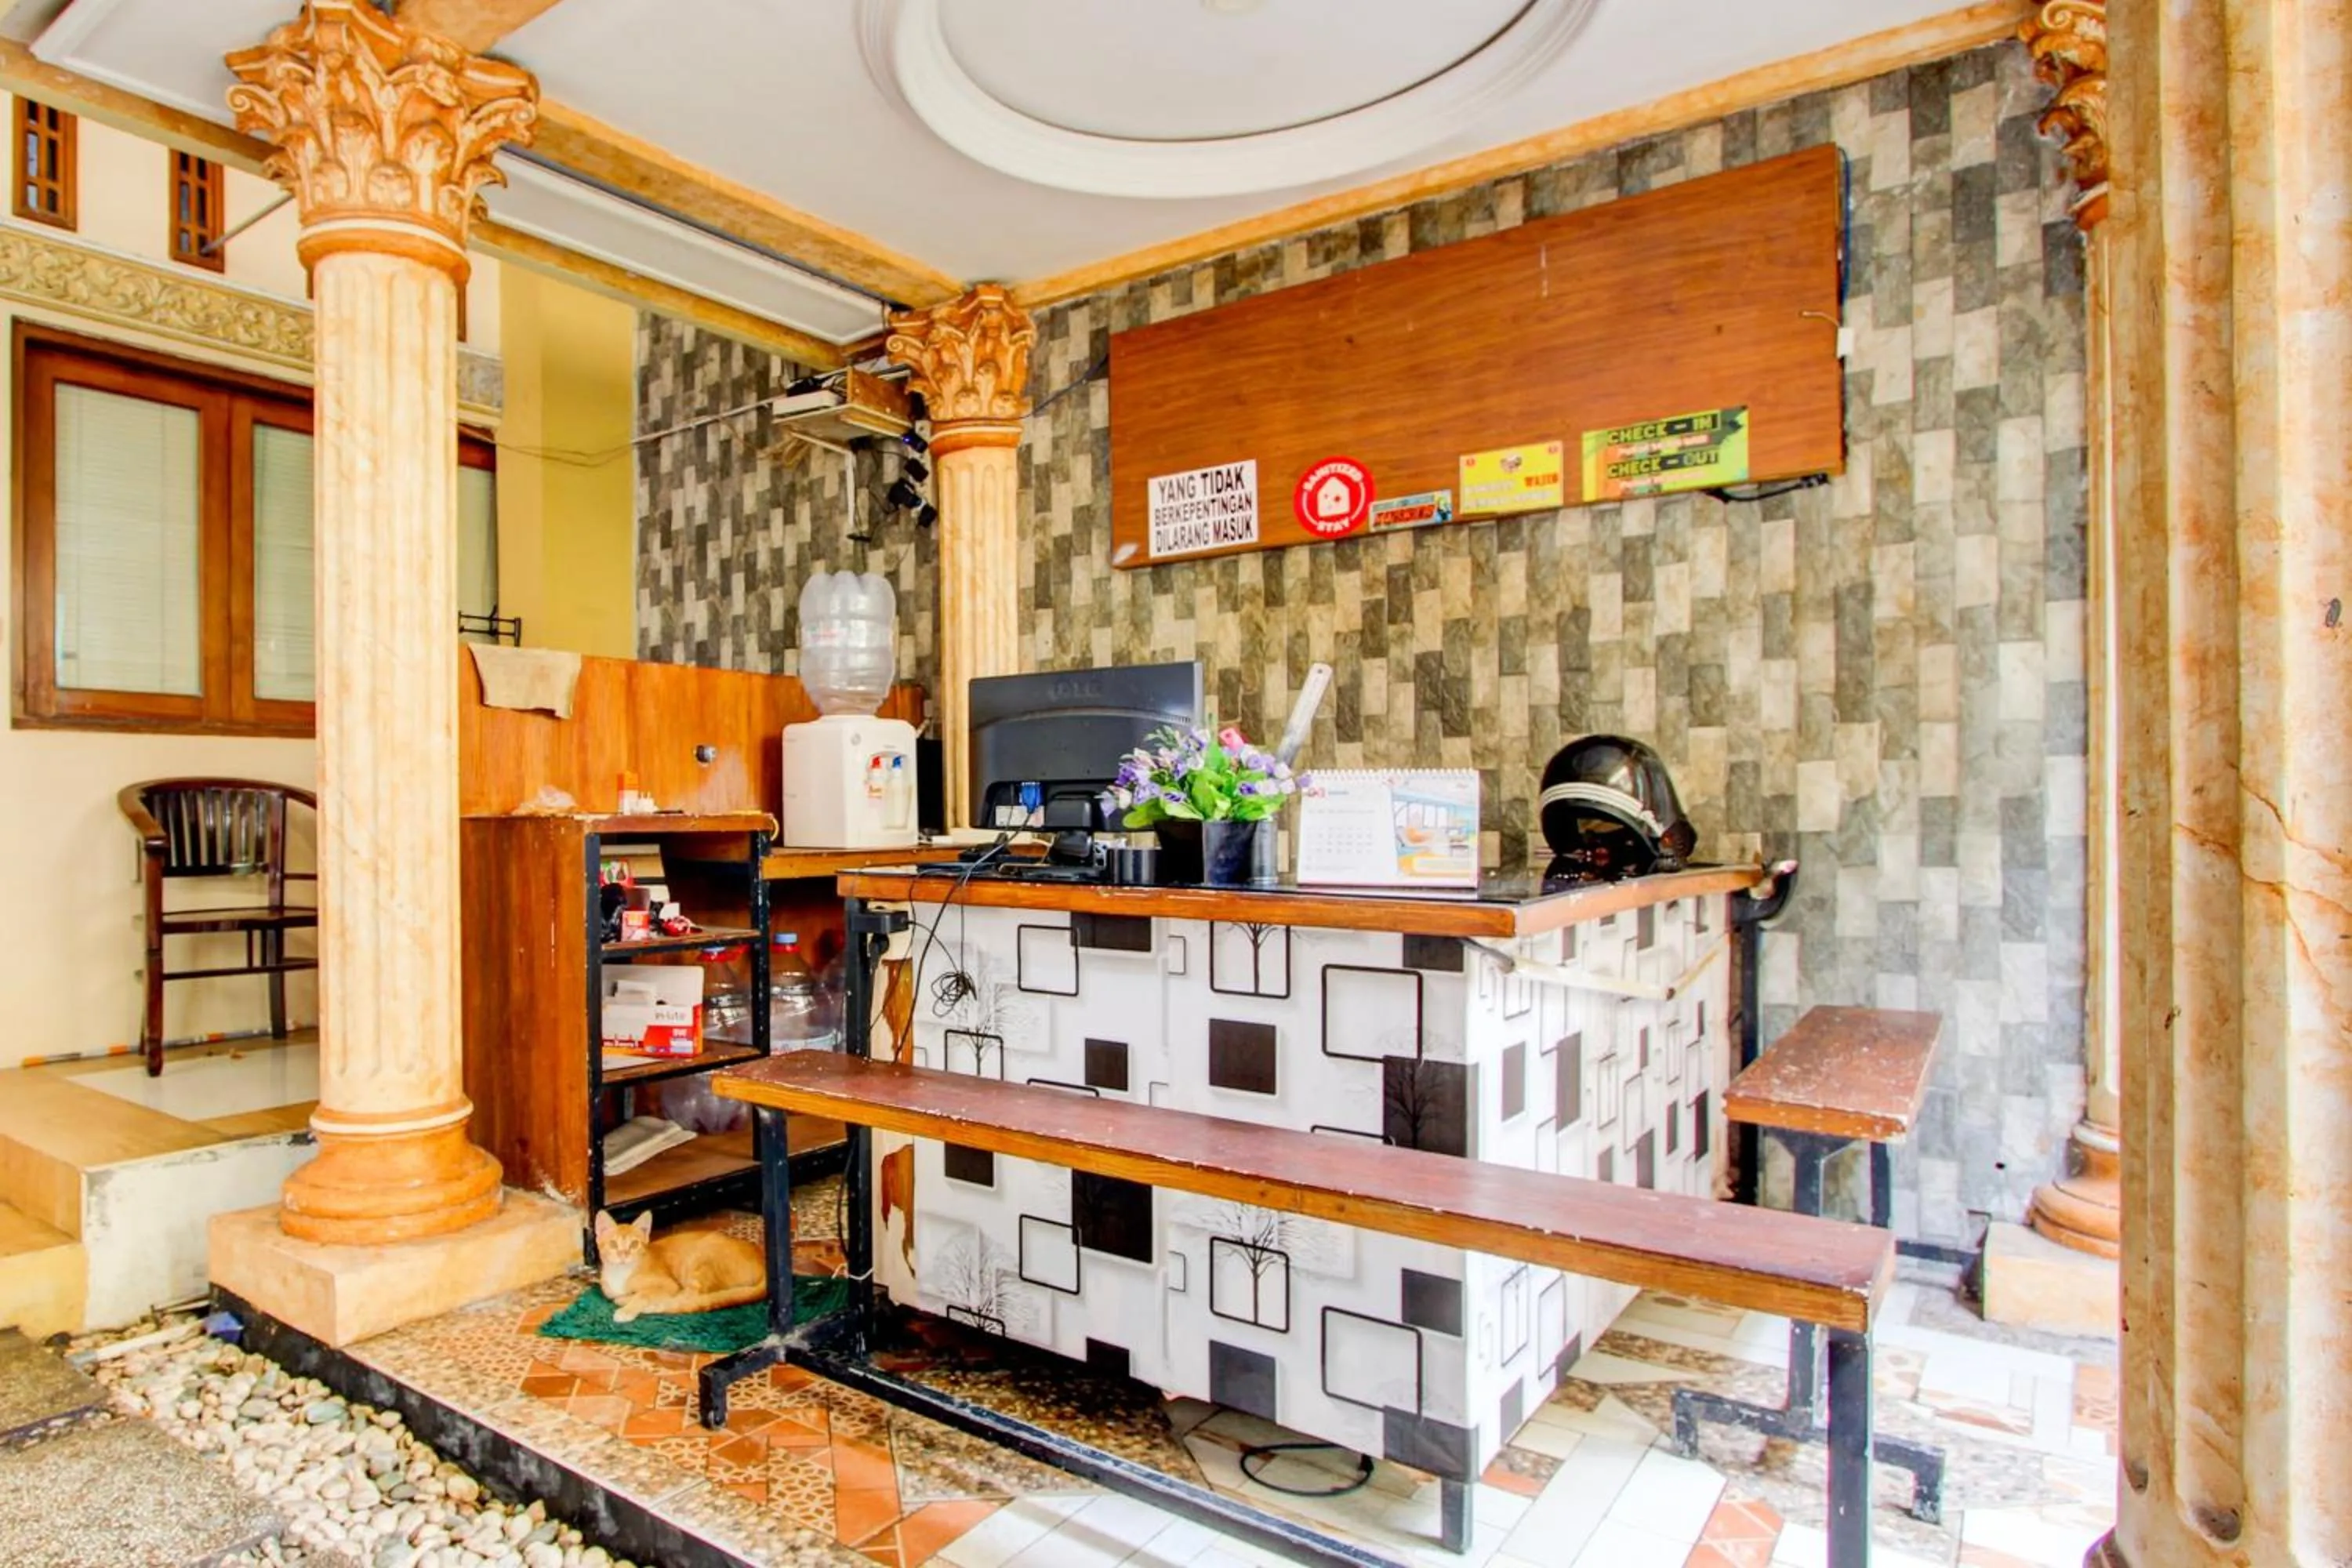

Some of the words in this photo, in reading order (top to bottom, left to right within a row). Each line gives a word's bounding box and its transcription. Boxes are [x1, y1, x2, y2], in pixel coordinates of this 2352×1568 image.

[1607, 423, 1668, 444] CHECK
[1607, 457, 1661, 477] CHECK
[1683, 451, 1719, 466] OUT
[1158, 475, 1196, 503] YANG
[1200, 465, 1245, 495] TIDAK
[1154, 492, 1252, 527] BERKEPENTINGAN
[1316, 517, 1350, 532] STAY
[1156, 522, 1210, 553] DILARANG
[1213, 515, 1253, 543] MASUK
